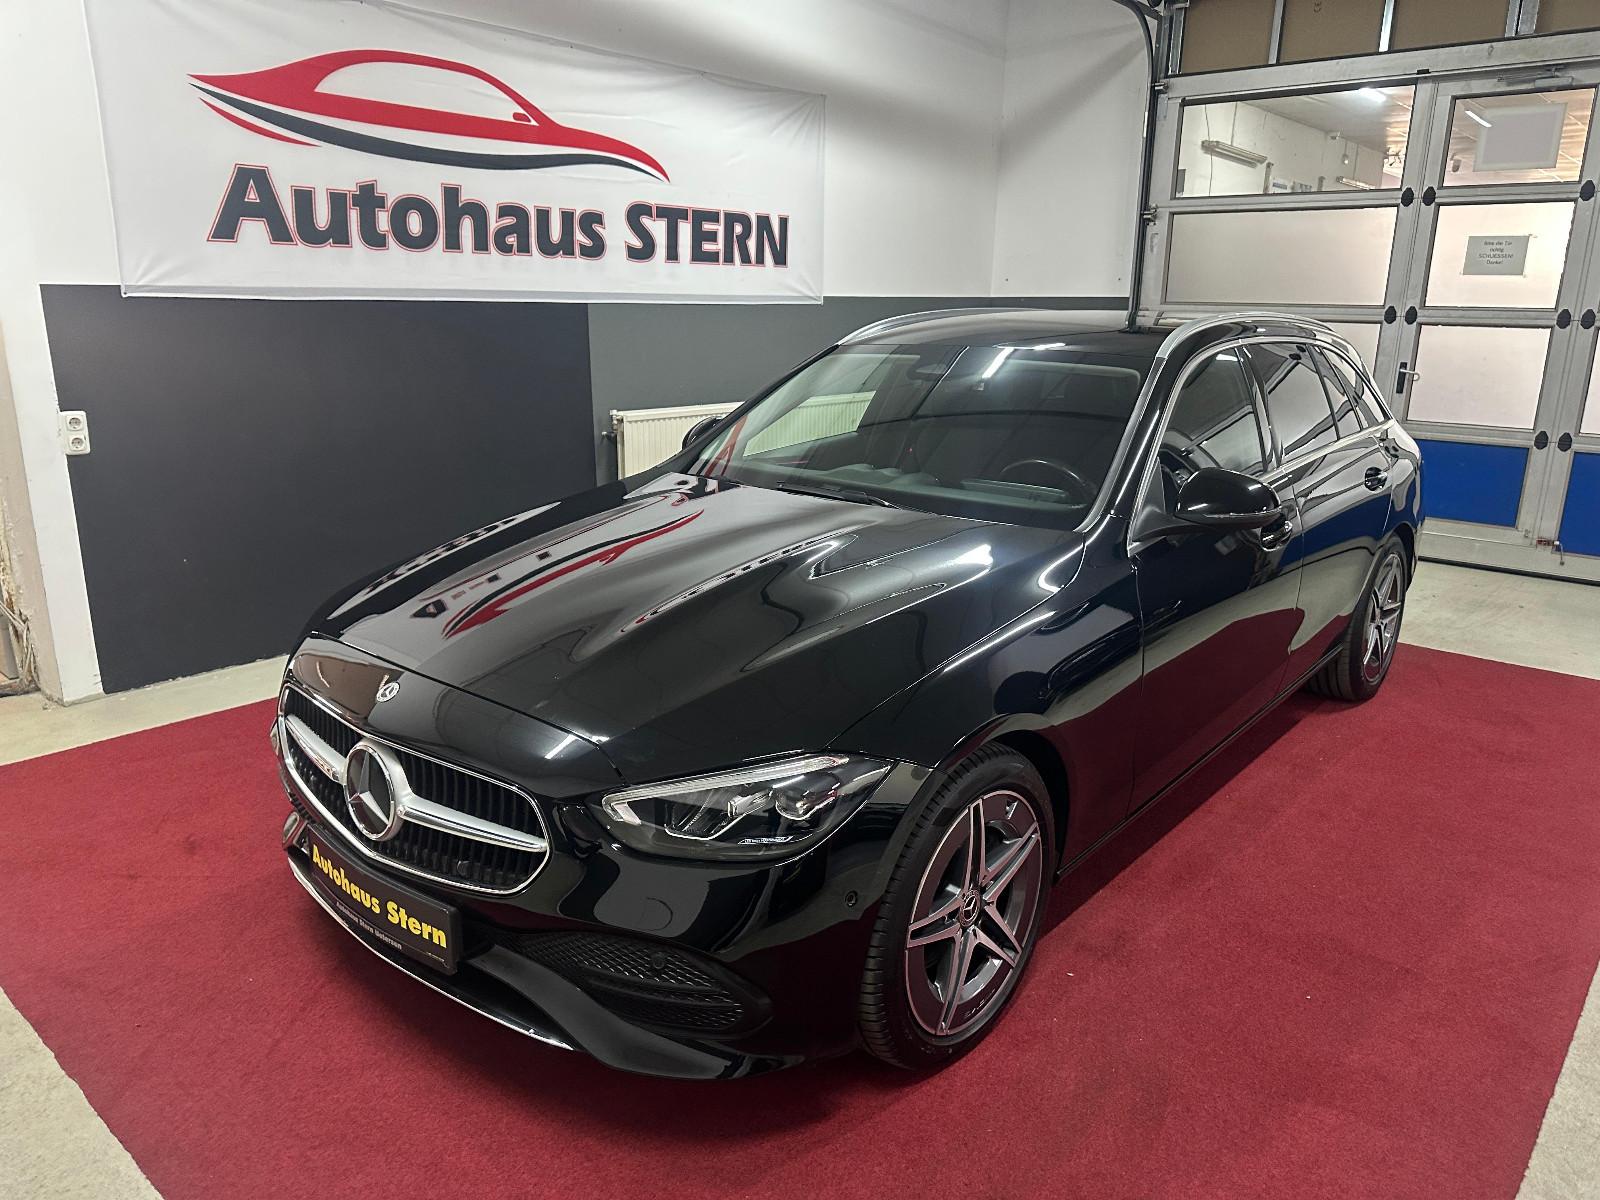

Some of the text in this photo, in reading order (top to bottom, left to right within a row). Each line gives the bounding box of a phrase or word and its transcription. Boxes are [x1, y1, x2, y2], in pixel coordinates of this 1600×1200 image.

[207, 163, 790, 268] Autohaus STERN
[312, 843, 447, 949] Autohaus Stern
